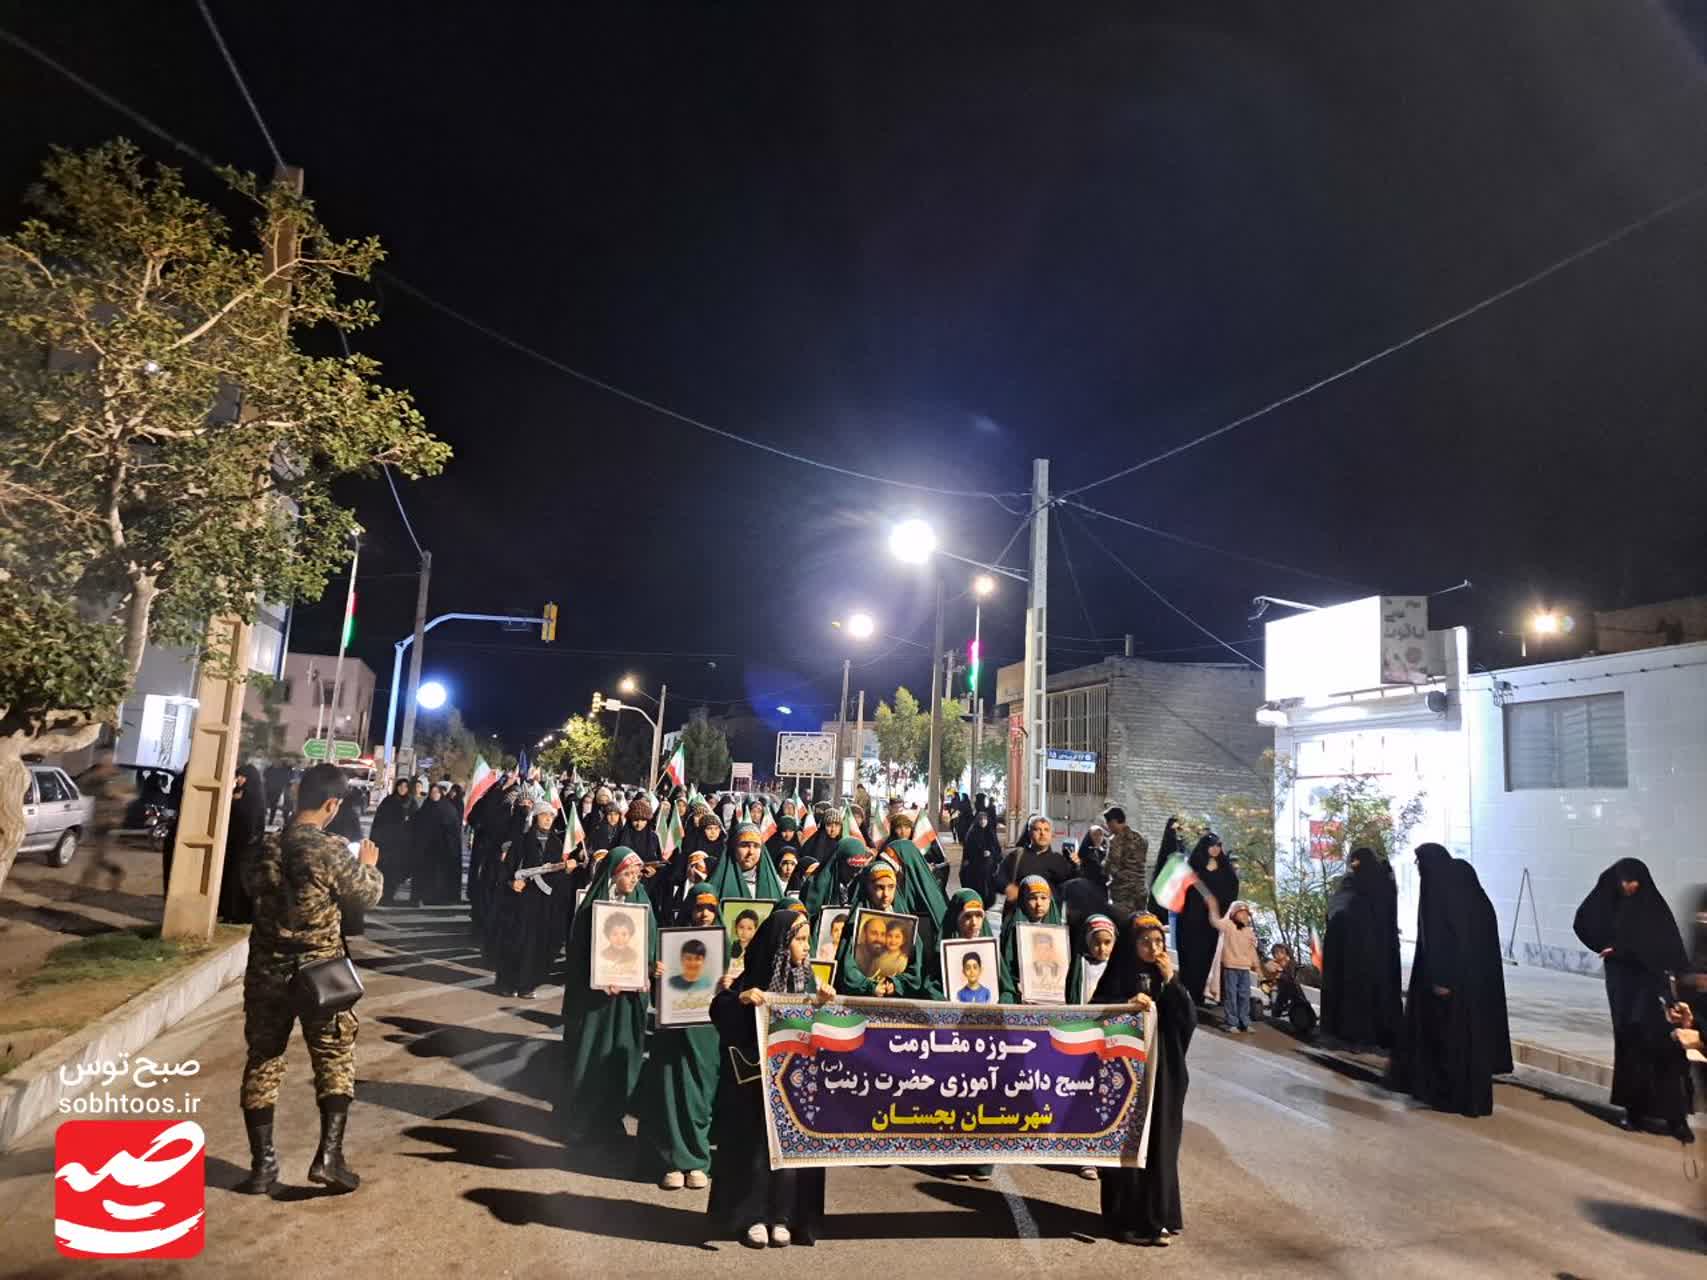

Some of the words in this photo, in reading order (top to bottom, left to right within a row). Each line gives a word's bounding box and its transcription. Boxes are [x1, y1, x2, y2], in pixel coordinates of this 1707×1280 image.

[889, 1030, 970, 1059] مقاومت
[975, 1036, 1037, 1060] حوزه
[825, 1070, 869, 1096] زینب
[875, 1069, 935, 1096] حضرت
[940, 1066, 999, 1097] آموزی
[1004, 1069, 1051, 1097] دانش
[1055, 1075, 1094, 1096] بسیج
[872, 1103, 956, 1131] بجستان
[961, 1104, 1053, 1131] شهرستان
